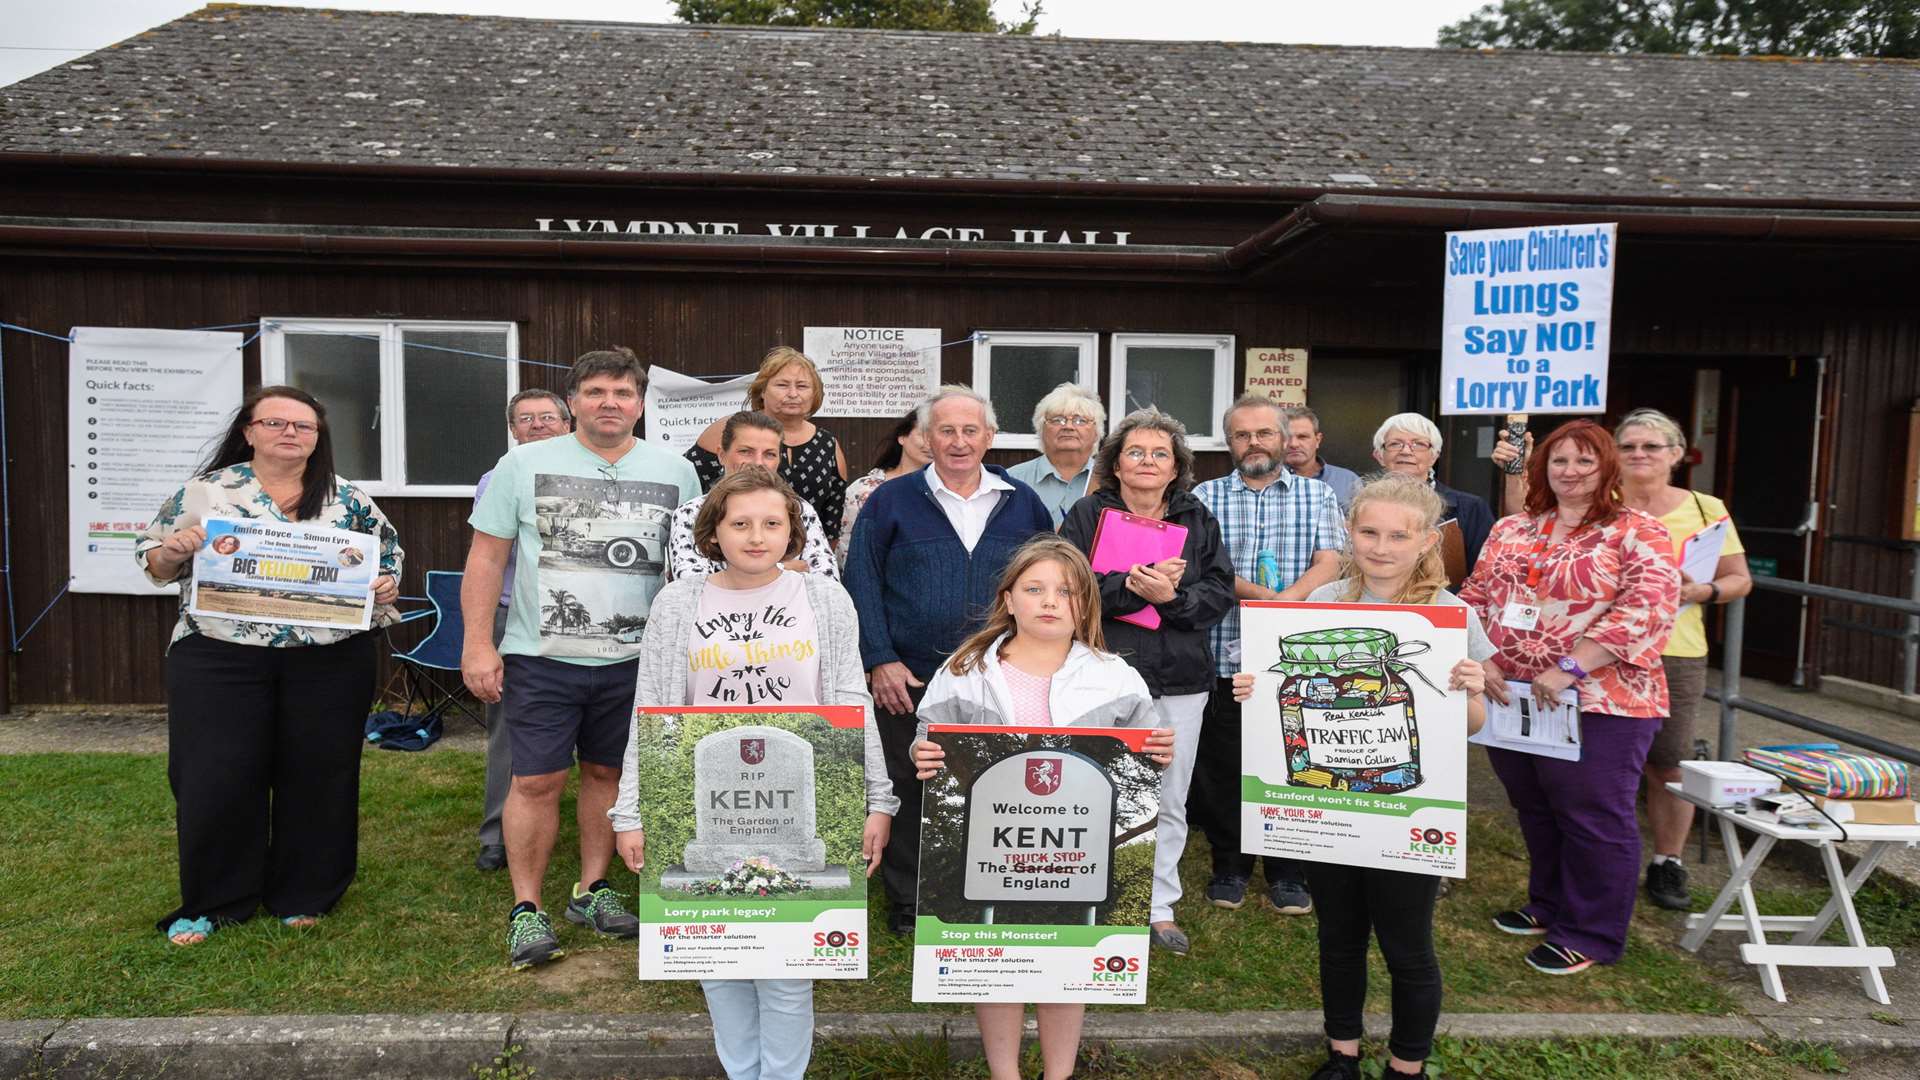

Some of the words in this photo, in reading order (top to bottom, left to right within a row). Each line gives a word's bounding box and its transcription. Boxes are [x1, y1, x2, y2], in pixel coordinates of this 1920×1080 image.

[1450, 236, 1485, 276] Save
[1489, 239, 1524, 278] your
[1528, 228, 1608, 272] Children's
[1474, 280, 1579, 317] Lungs
[844, 329, 904, 340] NOTICE
[1464, 326, 1528, 356] Say
[1536, 321, 1596, 352] NO!
[844, 342, 876, 350] Anyone
[832, 350, 865, 358] Lympne
[868, 350, 897, 358] Village
[1258, 352, 1295, 362] CARS
[866, 368, 926, 376] encompassed
[1264, 366, 1290, 374] ARE
[1507, 358, 1530, 374] to
[1536, 359, 1550, 373] a
[86, 380, 120, 390] Quick
[123, 380, 155, 391] facts:
[1249, 378, 1302, 386] PARKED
[828, 391, 886, 399] responsibility
[1456, 378, 1528, 411] Lorry
[1534, 374, 1600, 407] Park
[660, 417, 690, 426] Quick
[233, 526, 262, 536] Emilee
[265, 529, 292, 539] Boyce
[304, 533, 330, 543] Simon
[332, 536, 350, 546] Eyre
[232, 558, 257, 575] BIG
[258, 559, 310, 578] YELLOW
[311, 566, 339, 582] TAXI
[695, 612, 758, 640] Enjoy
[762, 605, 796, 628] the
[707, 675, 740, 702] In
[745, 675, 790, 705] Life
[1323, 711, 1345, 722] Real
[1306, 728, 1374, 744] TRAFFIC
[1377, 726, 1408, 744] JAM
[1326, 754, 1362, 764] Damian
[1365, 755, 1396, 765] Collins
[741, 772, 765, 780] RIP
[710, 790, 794, 809] KENT
[1264, 790, 1314, 802] Stanford
[1318, 795, 1352, 806] won't
[1354, 797, 1370, 808] fix
[1374, 799, 1407, 810] Stack
[992, 803, 1066, 814] Welcome
[1073, 804, 1089, 815] to
[1260, 806, 1280, 816] HAVE
[1284, 808, 1304, 818] YOUR
[1308, 810, 1323, 820] SAY
[712, 818, 734, 826] The
[737, 817, 778, 825] Garden
[783, 817, 794, 825] of
[730, 826, 777, 836] England
[992, 826, 1088, 848] KENT
[1410, 828, 1457, 846] SOS
[1410, 842, 1456, 855] KENT
[1004, 853, 1048, 864] TRUCK
[1054, 852, 1086, 863] STOP
[978, 862, 1007, 873] The
[1013, 862, 1075, 874] Garden
[1080, 863, 1096, 874] of
[1003, 876, 1070, 890] England
[664, 908, 698, 918] Lorry
[702, 907, 730, 918] park
[734, 907, 776, 918] legacy?
[660, 926, 680, 936] HAVE
[685, 924, 708, 935] YOUR
[710, 924, 726, 934] SAY
[941, 930, 970, 940] Stop
[974, 930, 998, 940] this
[1002, 930, 1057, 940] Monster!
[814, 931, 859, 948] SOS
[814, 948, 858, 956] KENT
[936, 948, 958, 958] HAVE
[962, 948, 984, 958] YOUR
[988, 948, 1004, 958] SAY
[1093, 956, 1139, 972] SOS
[1092, 972, 1138, 982] KENT
